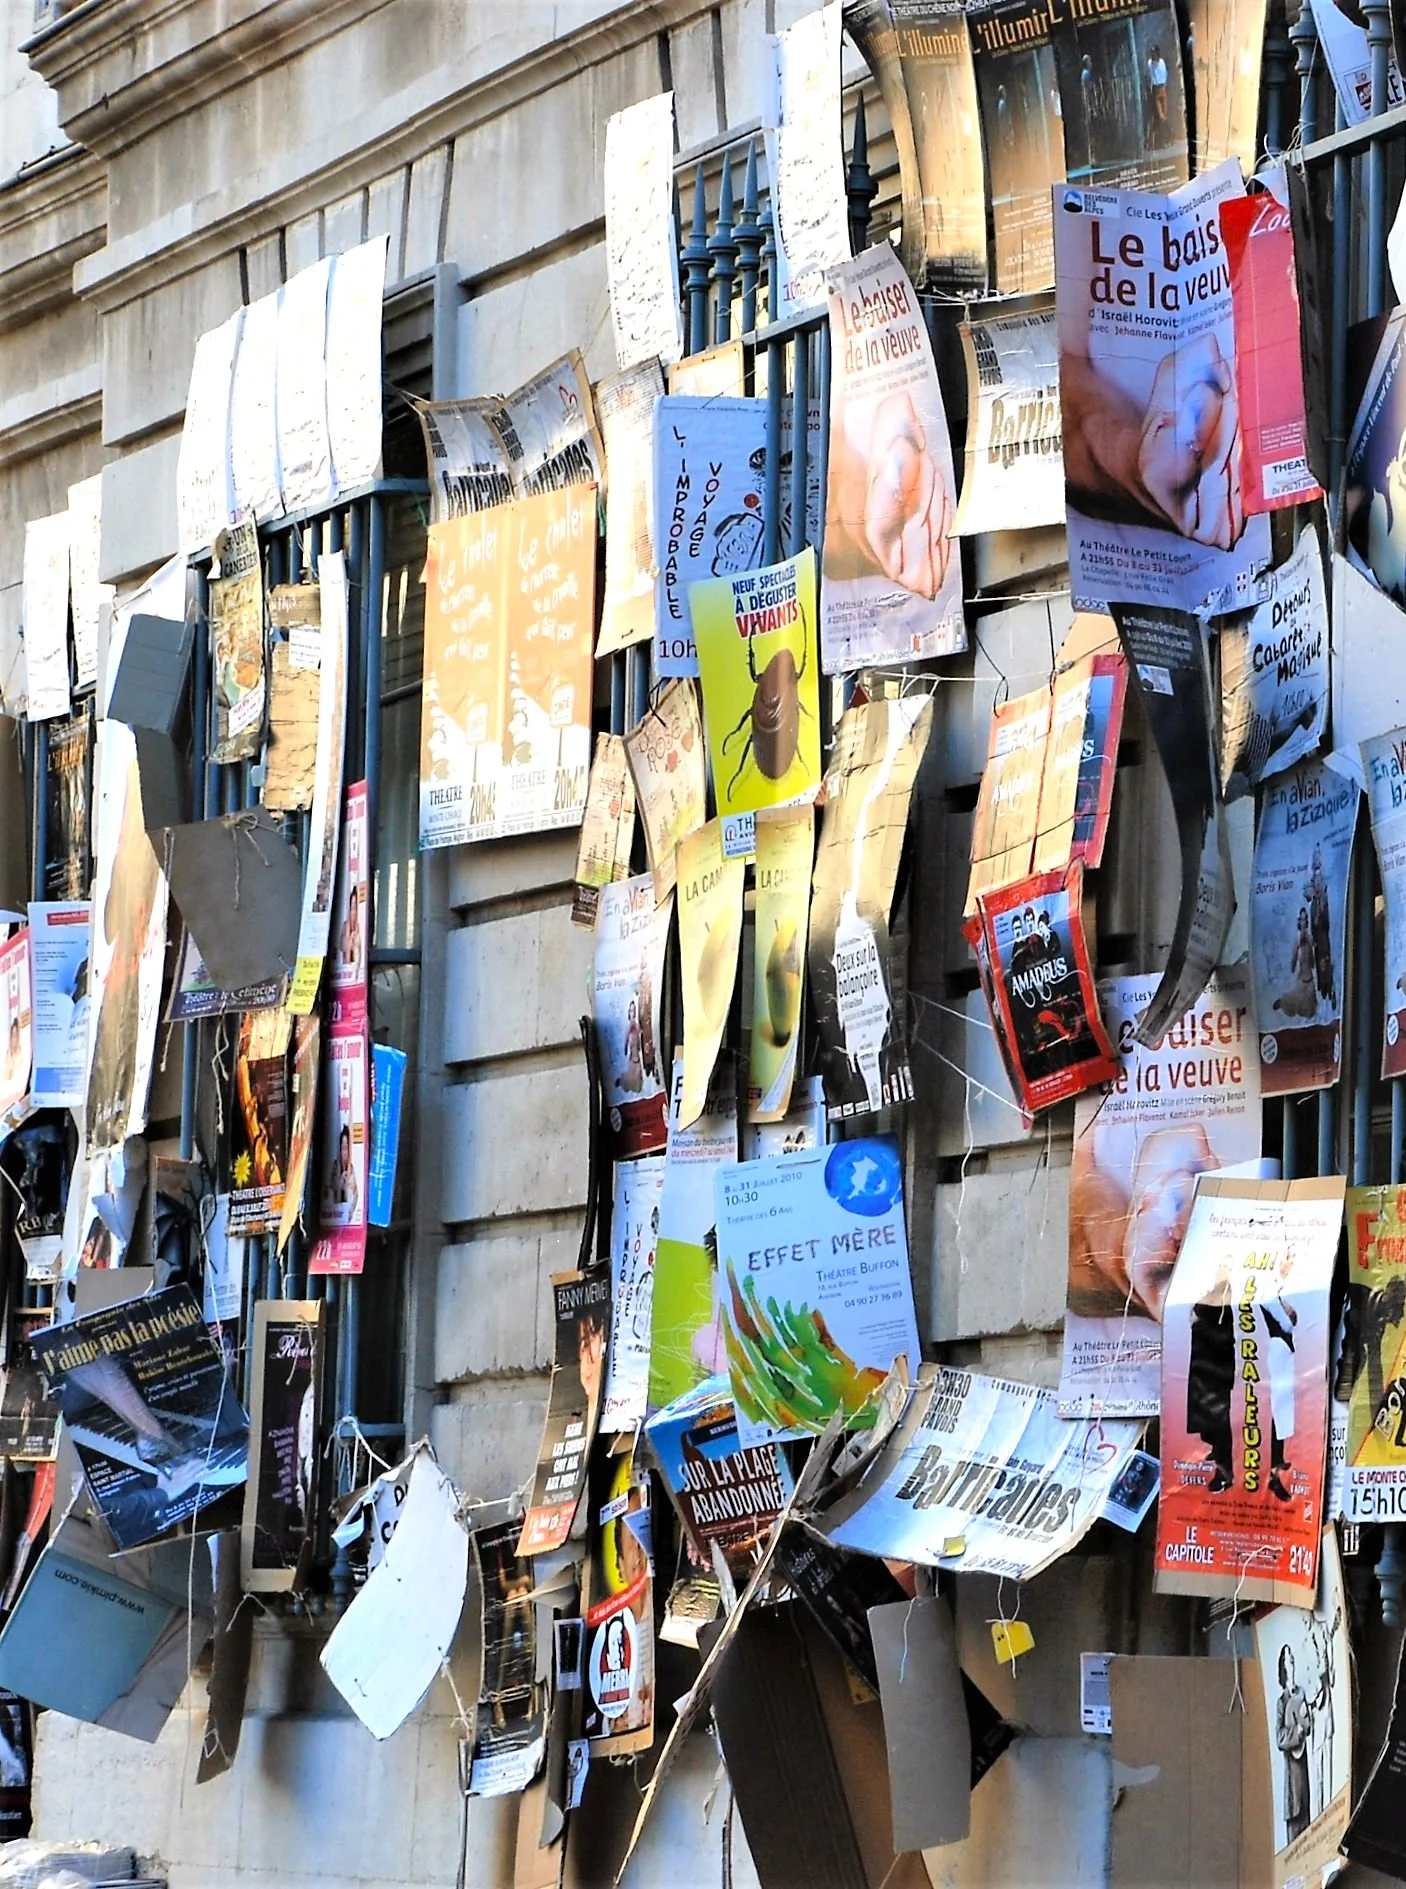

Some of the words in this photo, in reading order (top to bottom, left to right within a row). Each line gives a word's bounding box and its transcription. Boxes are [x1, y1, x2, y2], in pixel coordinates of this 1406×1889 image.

[1126, 207, 1142, 218] Cie
[1145, 209, 1162, 221] Les
[1091, 221, 1144, 268] Le
[1162, 214, 1220, 272] bais
[1090, 268, 1136, 306] de
[1149, 272, 1180, 311] la
[841, 296, 861, 337] Le
[862, 278, 911, 327] baiser
[866, 337, 881, 372] la
[882, 328, 921, 364] veuve
[689, 461, 722, 559] VOYAGE
[1080, 540, 1092, 550] Au
[1094, 541, 1130, 556] Théâtre
[1144, 549, 1166, 561] Petit
[1088, 553, 1115, 566] 21h55
[732, 578, 755, 597] NEUF
[758, 564, 796, 590] SPECTACLES
[735, 594, 745, 614] À
[748, 582, 797, 612] DÉGUSTER
[735, 600, 799, 639] VIVANTS
[429, 785, 463, 806] THEATRE
[685, 880, 700, 902] LA
[836, 949, 854, 974] Deux
[855, 947, 866, 969] sur
[1010, 955, 1069, 998] AMADEUS
[838, 966, 880, 998] balançoire
[1136, 1056, 1160, 1092] la
[1168, 1055, 1243, 1089] veuve
[780, 1171, 803, 1184] 2010
[748, 1239, 820, 1271] EFFET
[831, 1224, 896, 1255] MÈRE
[859, 1257, 899, 1275] BUFFON
[1238, 1275, 1258, 1334] LES
[42, 1336, 100, 1376] J'aime
[101, 1328, 132, 1357] pas
[131, 1321, 151, 1344] la
[150, 1301, 201, 1337] poésie
[921, 1412, 958, 1433] PAVOIS
[1240, 1337, 1262, 1494] RALEURS
[678, 1459, 711, 1493] SUR
[712, 1457, 734, 1487] LA
[736, 1443, 780, 1483] PLAGE
[1351, 1469, 1364, 1485] LE
[1366, 1469, 1397, 1485] MONTE
[1185, 1525, 1197, 1547] LE
[1165, 1542, 1215, 1566] CAPITOLE
[53, 1568, 145, 1616] www.pimkie.com
